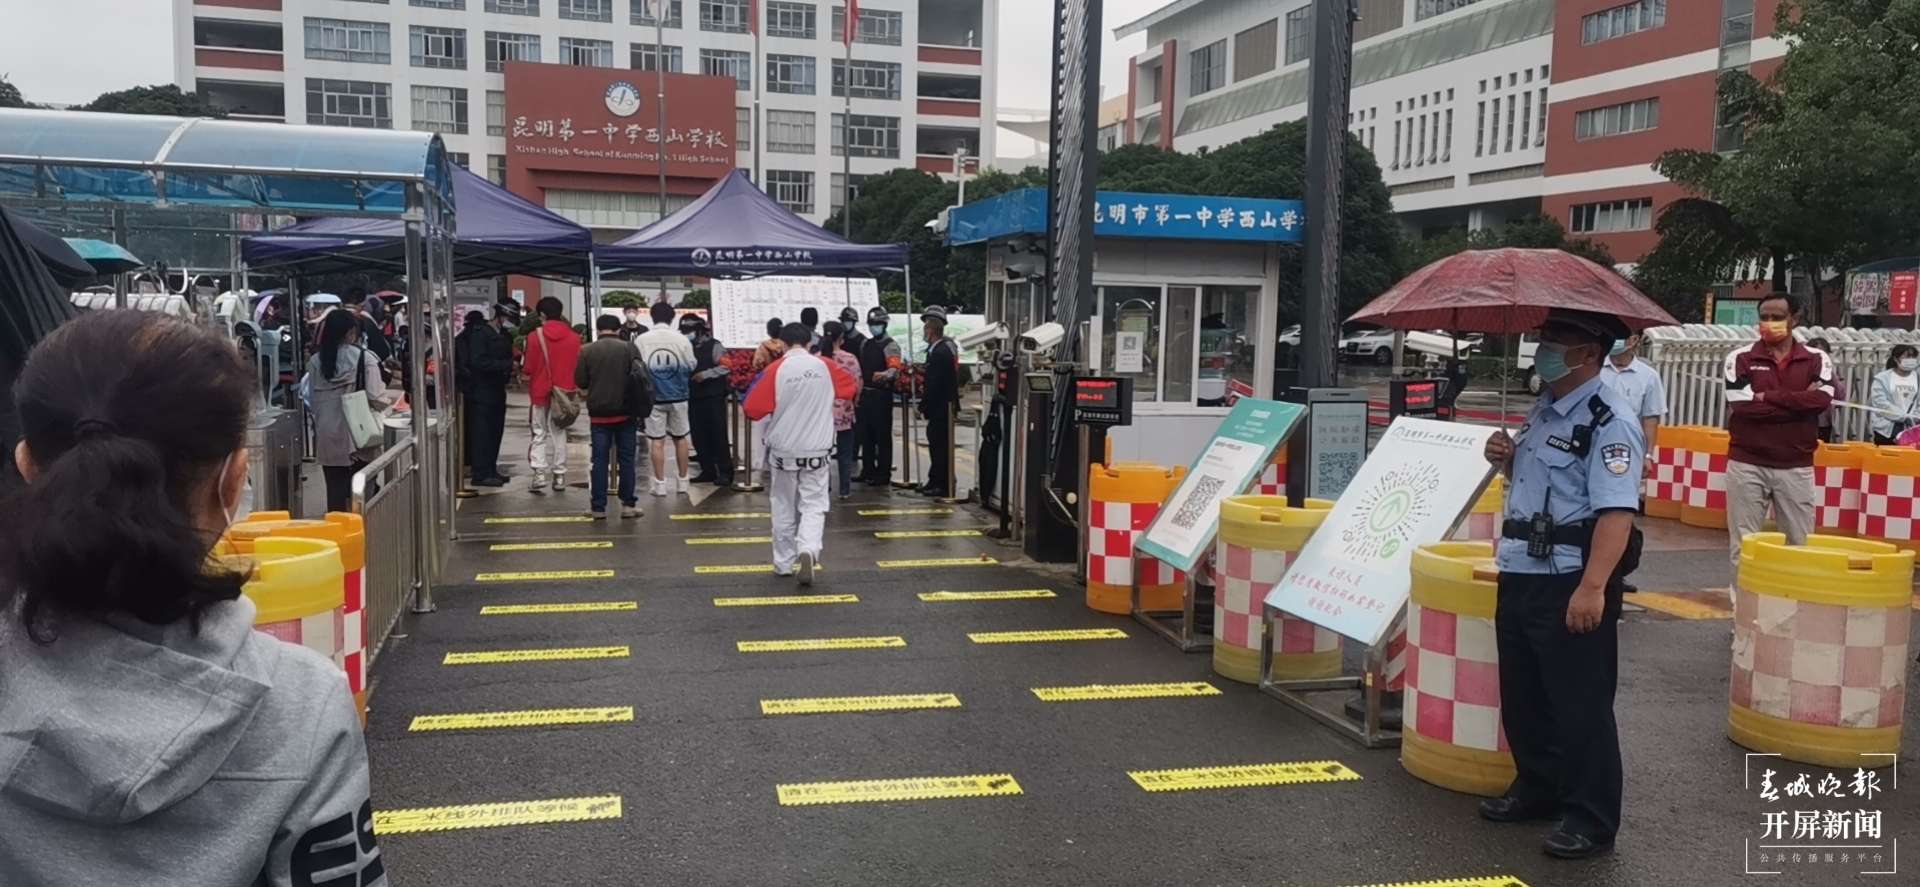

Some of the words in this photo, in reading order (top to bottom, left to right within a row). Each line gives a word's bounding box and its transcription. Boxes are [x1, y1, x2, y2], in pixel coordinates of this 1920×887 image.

[512, 116, 728, 149] 昆明第一中学西山学校
